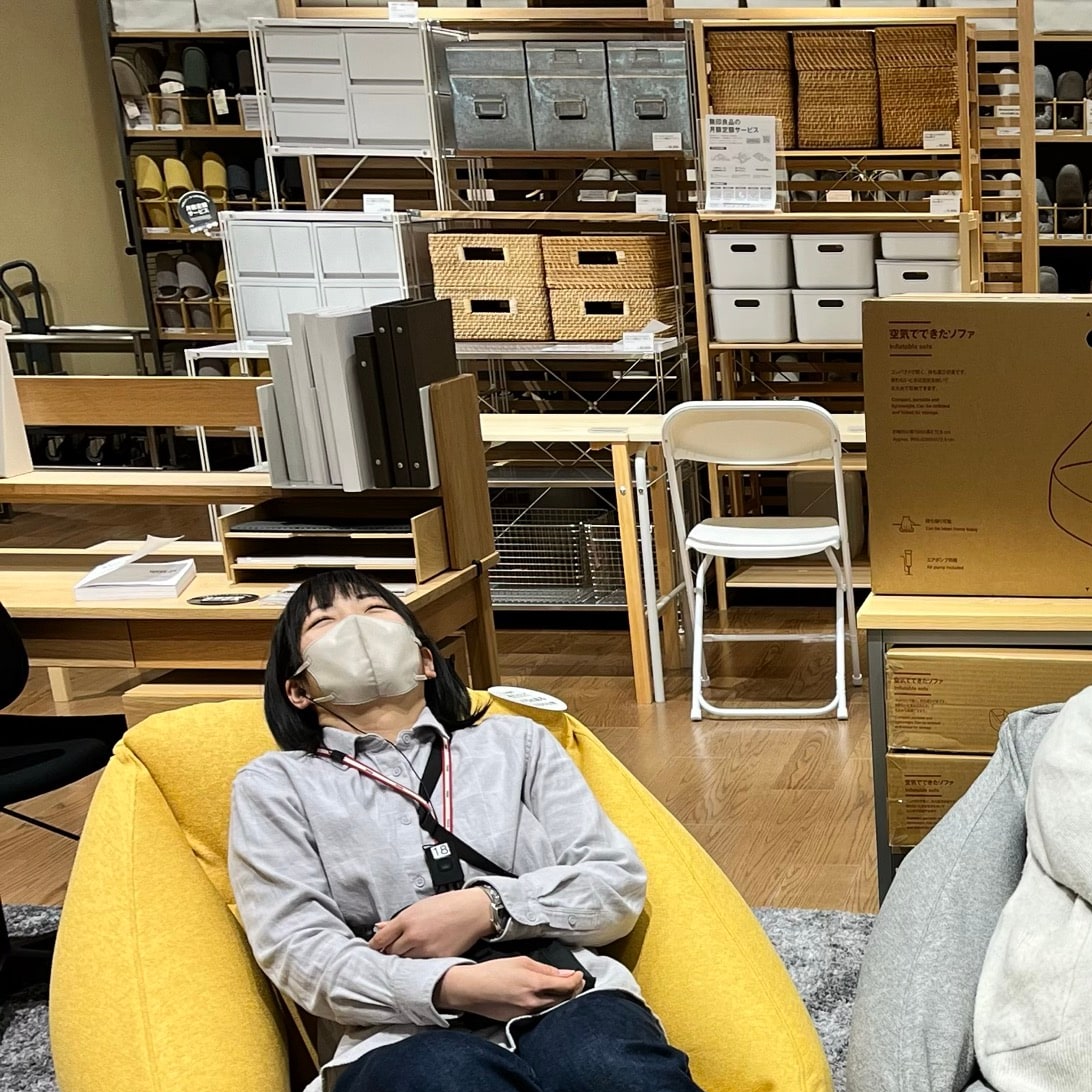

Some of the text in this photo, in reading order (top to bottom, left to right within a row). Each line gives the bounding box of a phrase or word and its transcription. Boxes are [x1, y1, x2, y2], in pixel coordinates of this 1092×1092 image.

[889, 328, 975, 340] 空気でできたソファ
[434, 844, 449, 856] 18
